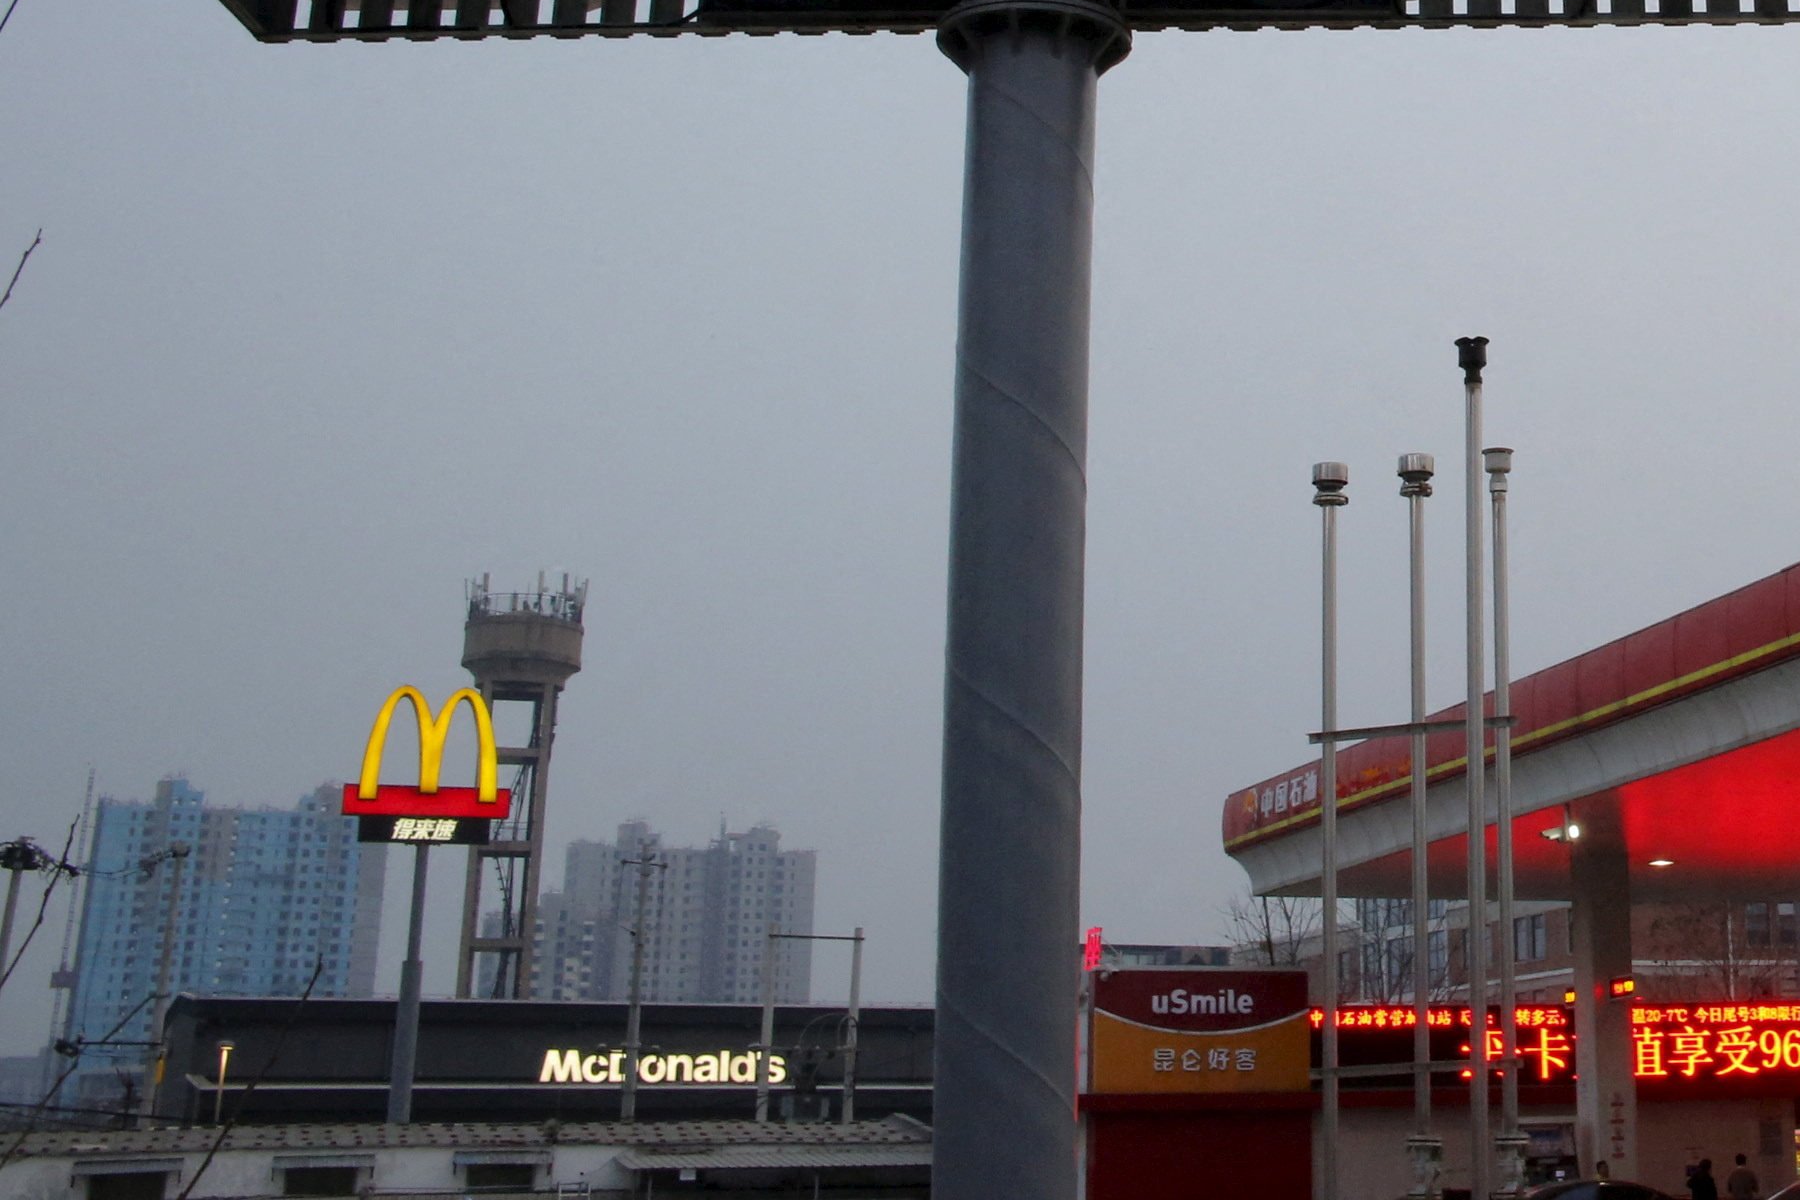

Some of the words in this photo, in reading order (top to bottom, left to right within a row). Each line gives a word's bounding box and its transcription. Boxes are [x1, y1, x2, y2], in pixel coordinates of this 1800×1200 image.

[1260, 769, 1318, 818] 中国石油
[391, 817, 458, 841] 得来速
[1151, 988, 1254, 1015] uSmile
[539, 1049, 786, 1083] McDonald's
[1153, 1047, 1257, 1073] 昆仑好客
